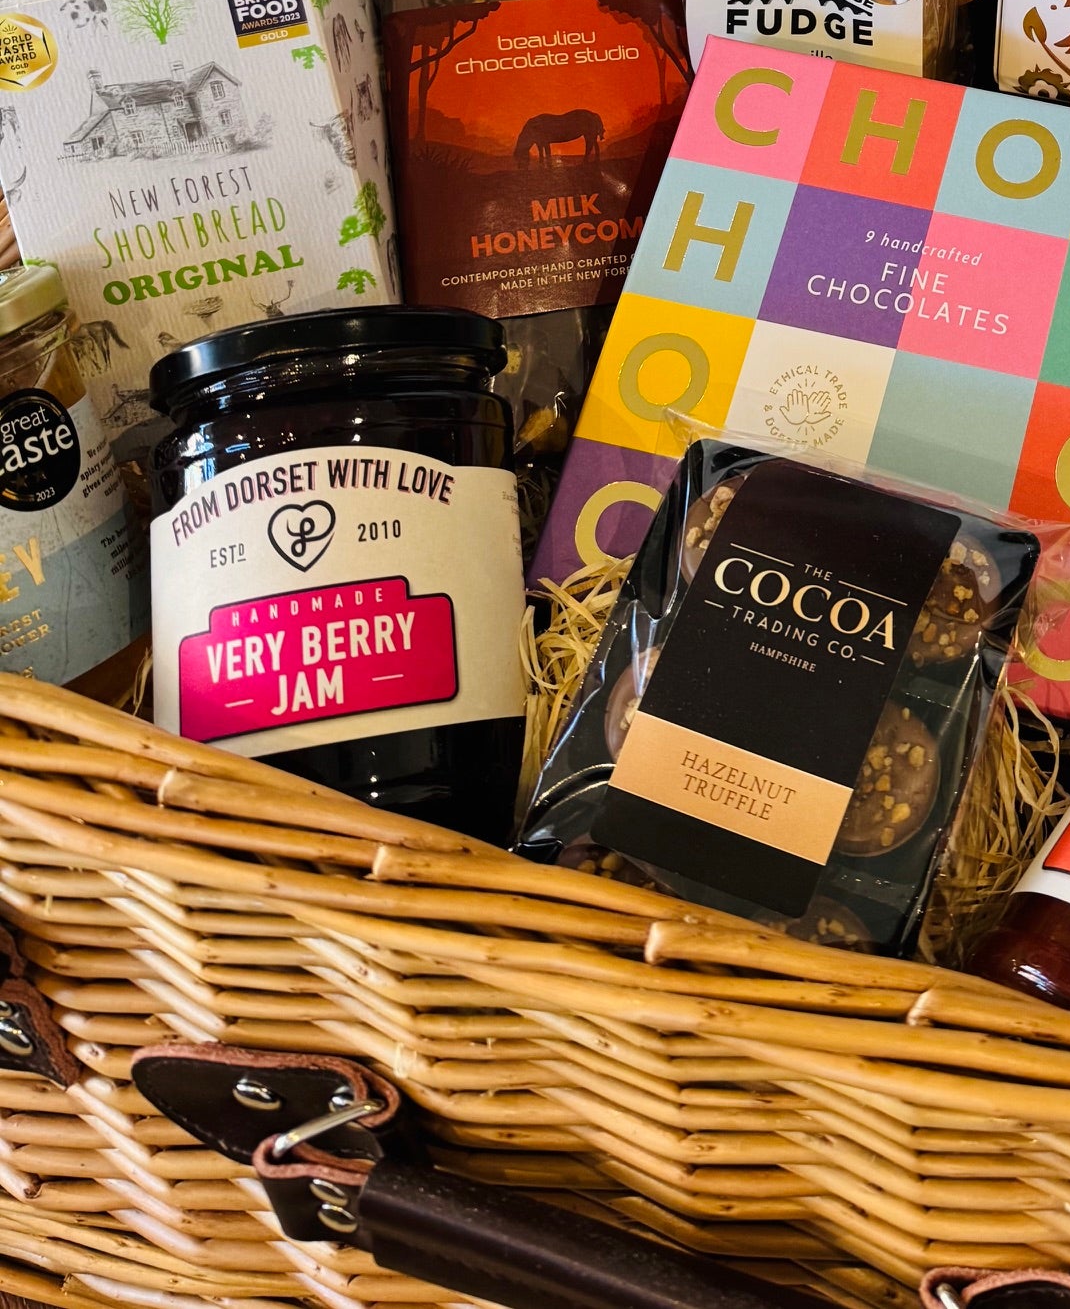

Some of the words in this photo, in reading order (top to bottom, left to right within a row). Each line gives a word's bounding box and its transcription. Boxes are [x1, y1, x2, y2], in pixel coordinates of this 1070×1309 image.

[241, 15, 279, 31] AWARDS
[260, 28, 288, 42] GOLD
[497, 30, 596, 51] beaulieu
[727, 8, 873, 46] FUDGE
[455, 50, 570, 75] chocolate
[574, 45, 640, 63] studio
[109, 180, 161, 219] NEW
[171, 166, 253, 206] FOREST
[531, 194, 601, 222] MILK
[94, 197, 286, 269] SHORTBREAD
[880, 233, 983, 267] handcrafted
[102, 244, 304, 306] ORIGINAL
[441, 265, 538, 287] CONTEMPORARY
[541, 261, 575, 273] HAND
[577, 254, 627, 268] CRAFTED
[500, 278, 534, 291] MADE
[880, 262, 948, 294] FINE
[807, 274, 1010, 335] CHOCOLATES
[172, 494, 221, 548] FROM
[224, 461, 319, 511] DORSET
[327, 458, 389, 489] WITH
[398, 462, 456, 505] LOVE
[357, 519, 402, 542] 2010
[804, 563, 833, 581] THE
[231, 588, 384, 627] HANDMADE
[714, 557, 896, 651] COCOA
[732, 605, 819, 648] TRADING
[207, 630, 287, 683] VERY
[301, 611, 416, 666] BERRY
[749, 641, 817, 673] HAMPSHIRE
[271, 665, 344, 716] JAM
[680, 750, 797, 805] HAZELNUT
[682, 773, 773, 821] TRUFFLE
